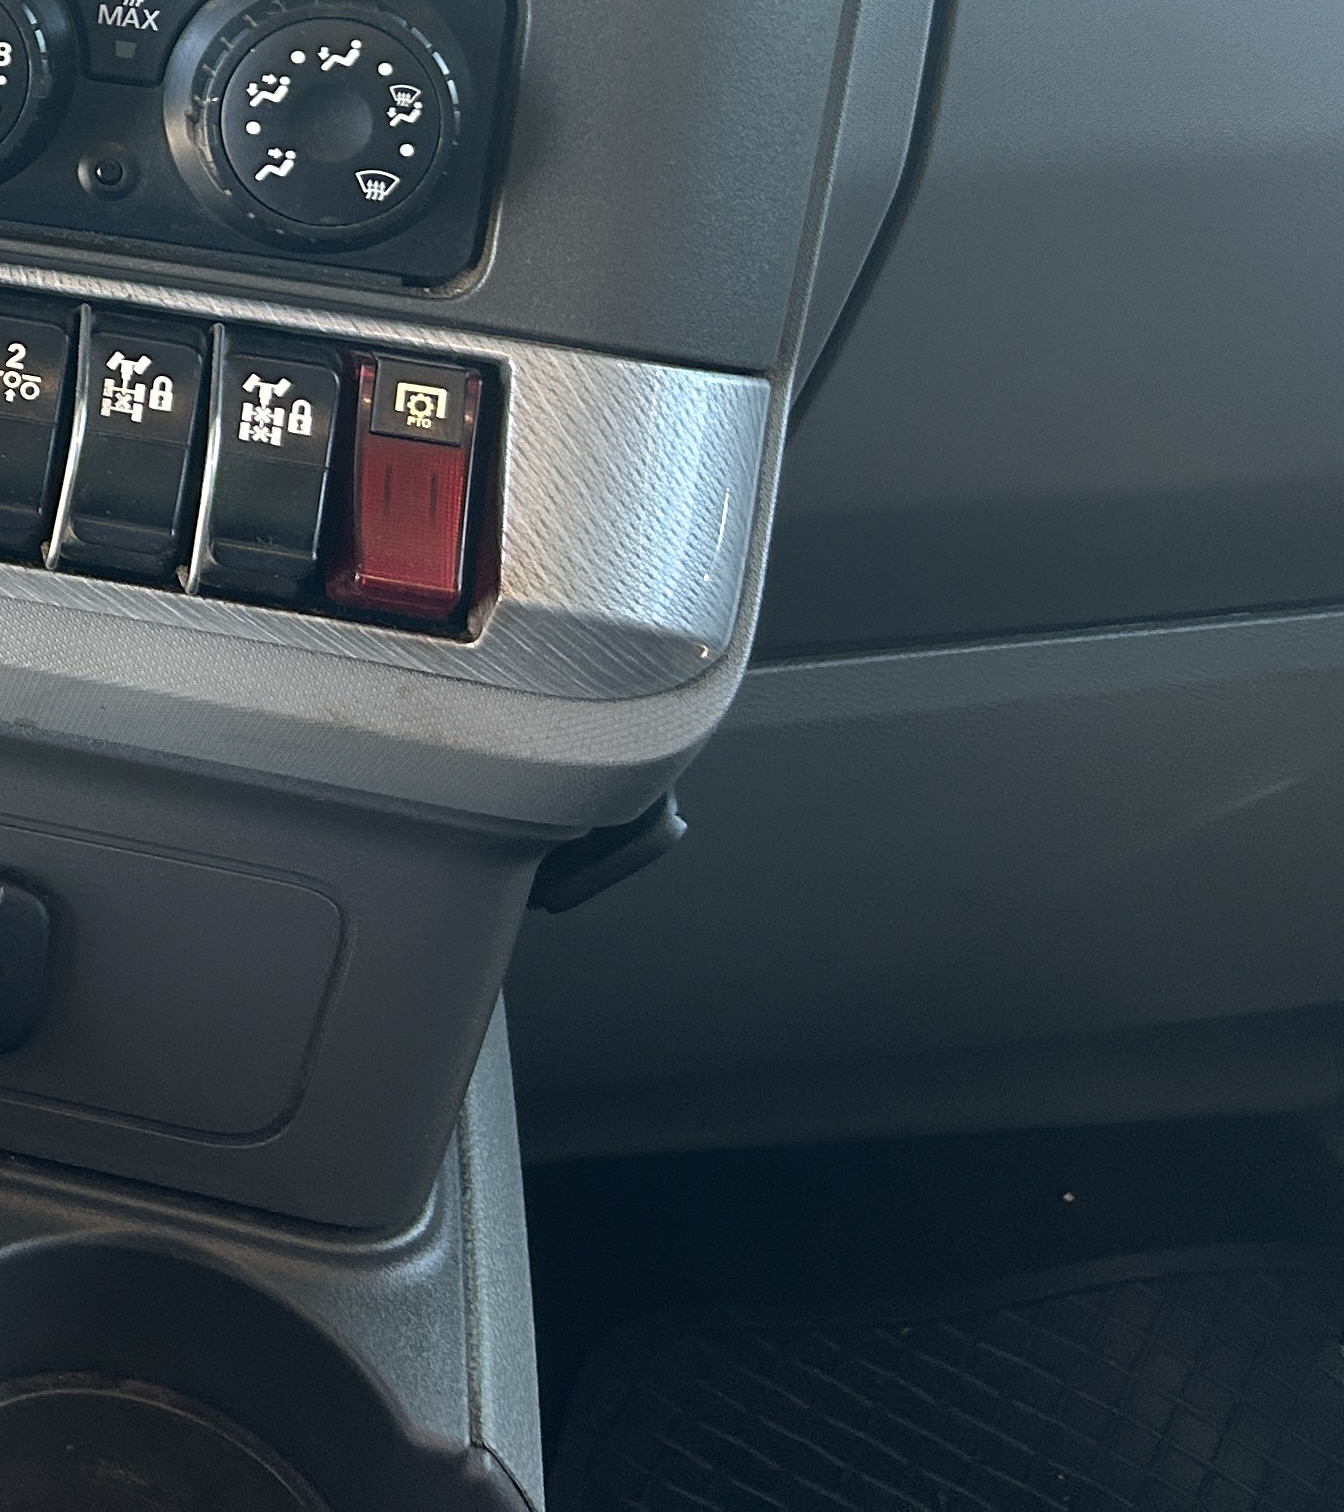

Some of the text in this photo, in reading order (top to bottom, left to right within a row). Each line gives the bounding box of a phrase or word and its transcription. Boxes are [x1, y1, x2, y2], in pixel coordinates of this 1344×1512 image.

[96, 3, 161, 33] MAX
[6, 344, 26, 370] 2
[406, 414, 433, 430] PTO
